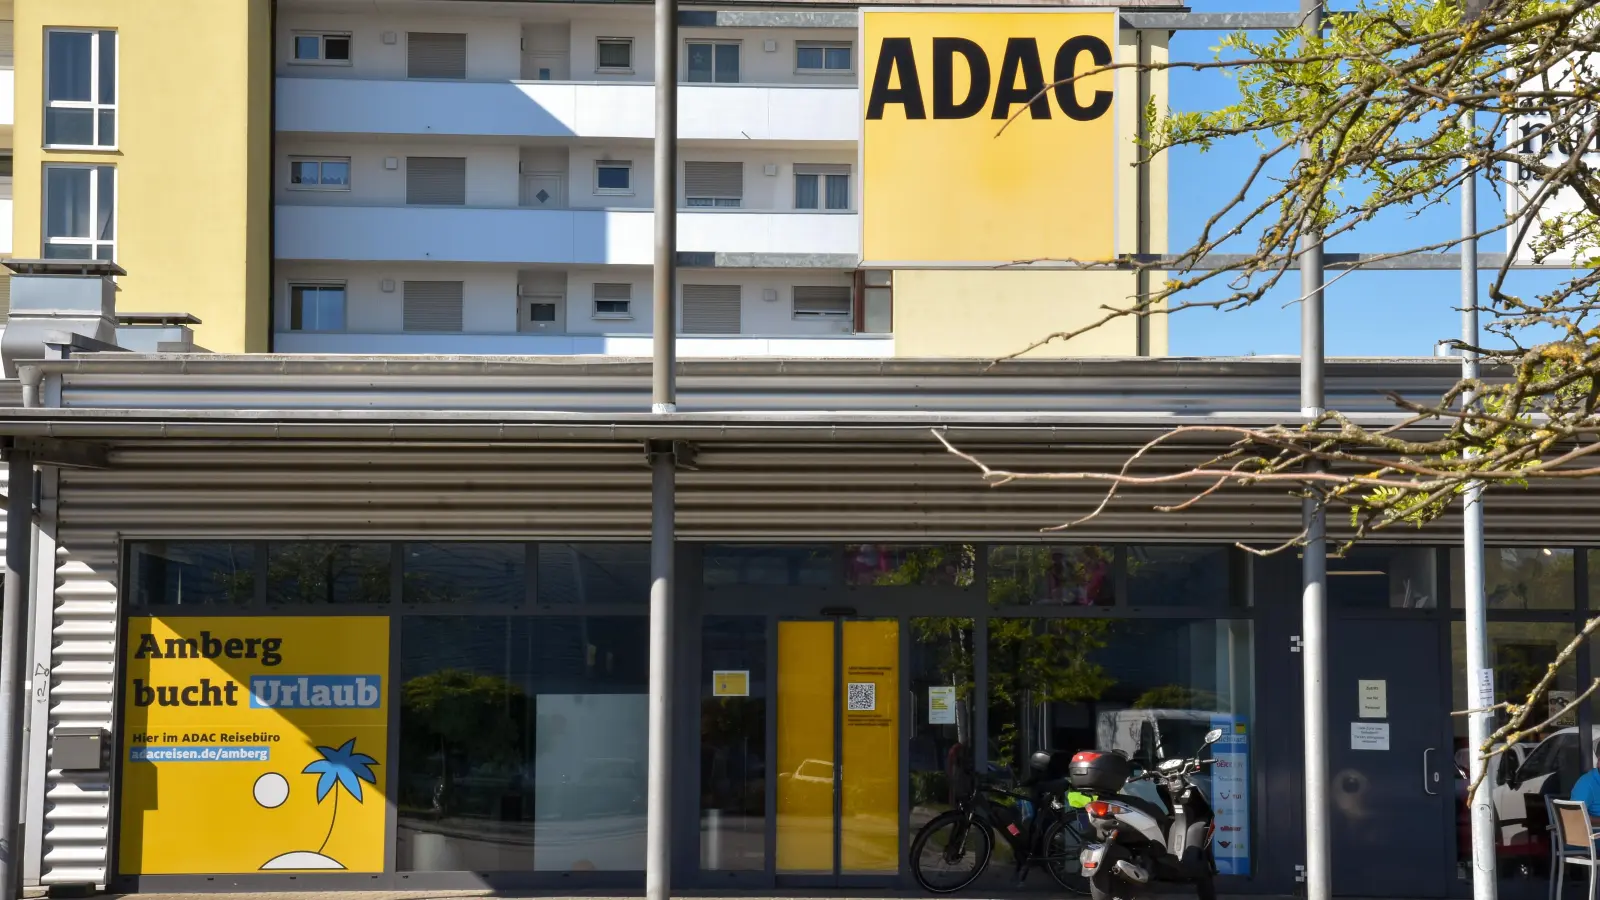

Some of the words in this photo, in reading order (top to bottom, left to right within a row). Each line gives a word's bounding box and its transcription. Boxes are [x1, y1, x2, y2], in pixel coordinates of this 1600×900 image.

[866, 35, 1113, 121] ADAC
[134, 631, 282, 666] Amberg
[133, 679, 238, 707] bucht
[253, 678, 378, 707] Urlaub
[132, 733, 159, 743] Hier
[163, 733, 178, 743] im
[182, 733, 216, 743] ADAC
[220, 732, 280, 743] Reisebüro
[131, 748, 267, 761] adacreisen.de/amberg
